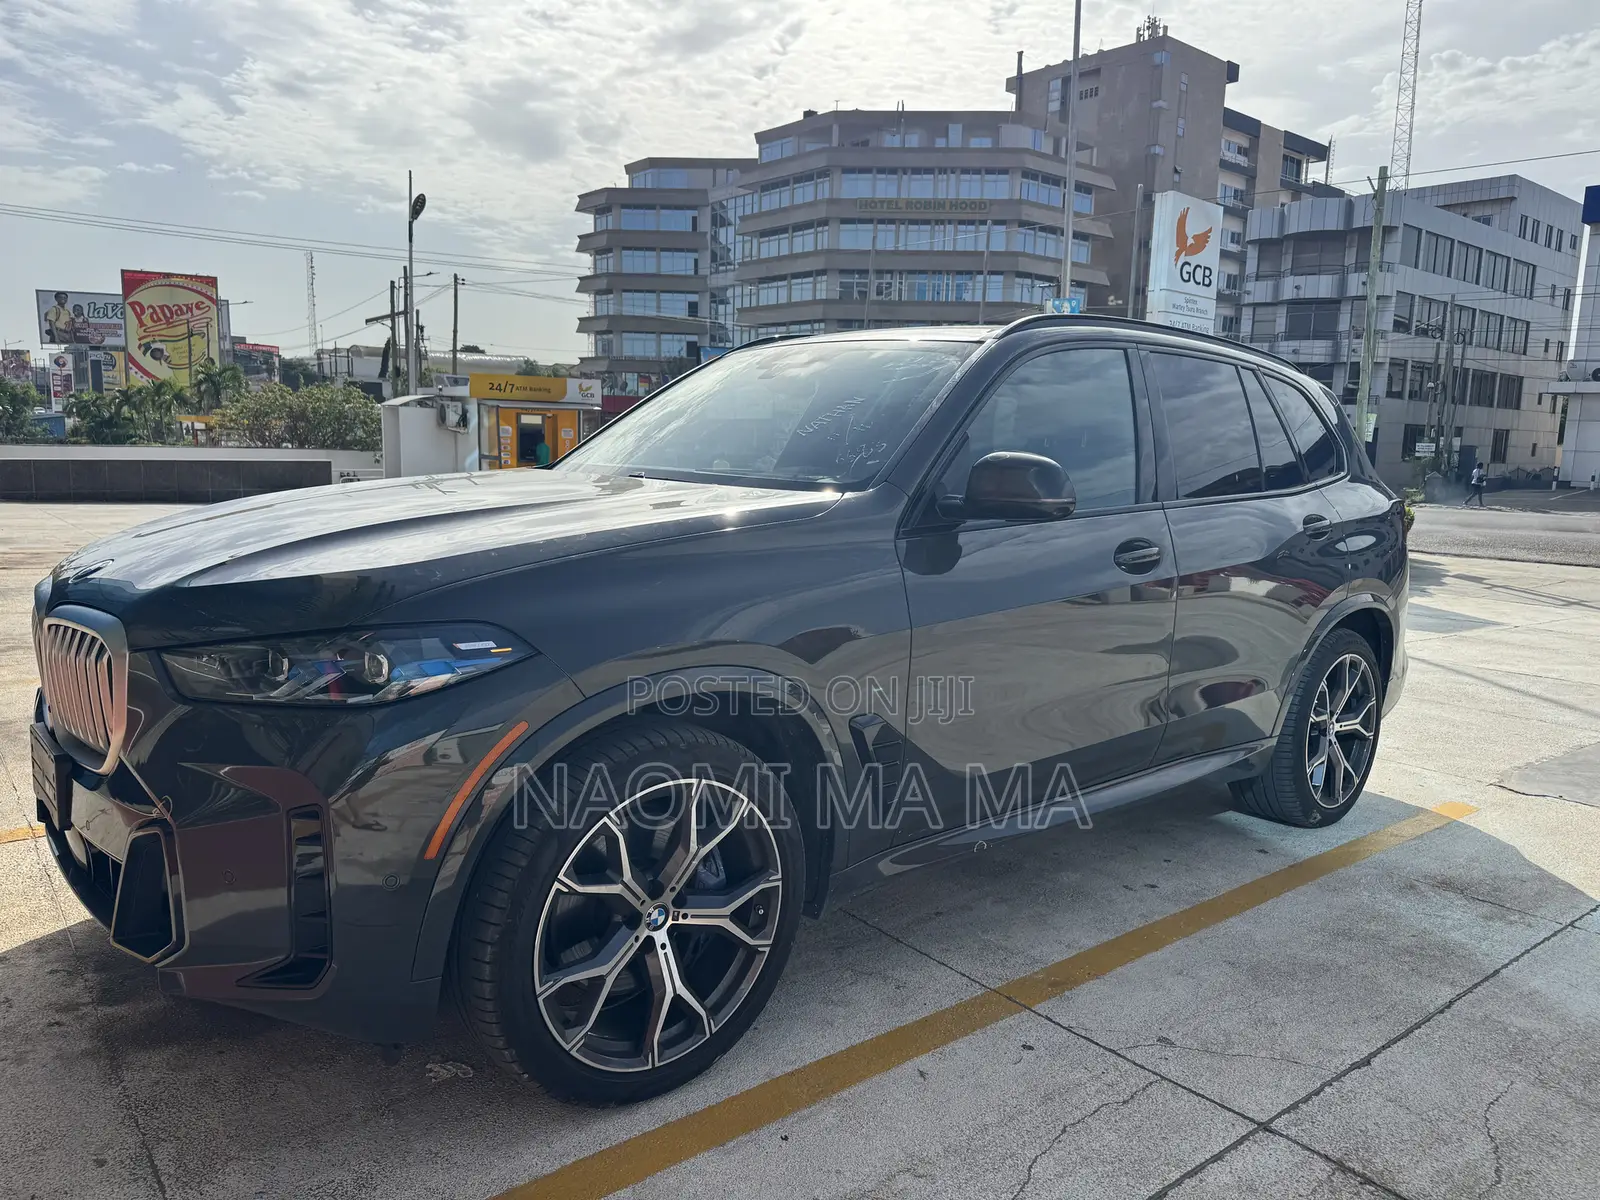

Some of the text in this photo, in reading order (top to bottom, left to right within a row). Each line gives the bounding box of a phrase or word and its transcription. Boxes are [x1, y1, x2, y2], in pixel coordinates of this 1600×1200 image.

[859, 199, 987, 211] HOTEL ROBIN HOOD
[1179, 260, 1212, 287] GCB
[127, 300, 210, 329] Papaye
[488, 380, 515, 393] 24/7
